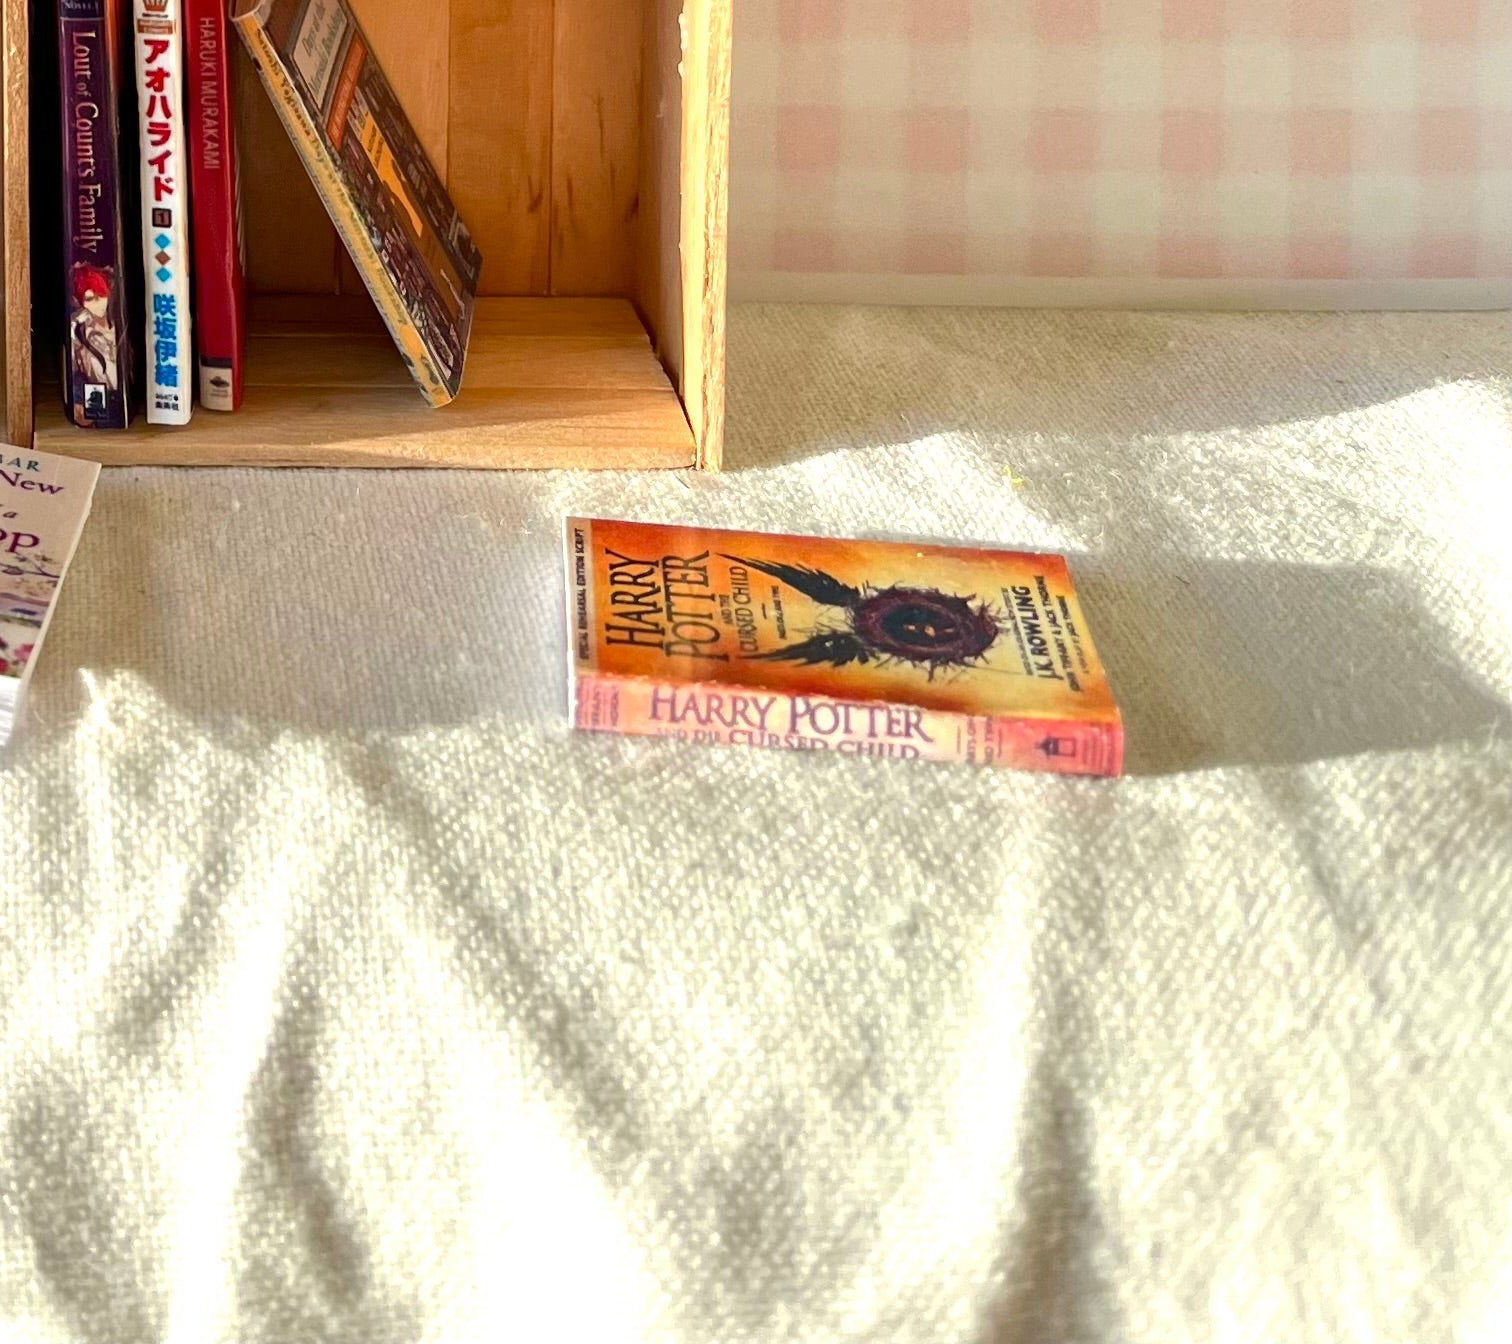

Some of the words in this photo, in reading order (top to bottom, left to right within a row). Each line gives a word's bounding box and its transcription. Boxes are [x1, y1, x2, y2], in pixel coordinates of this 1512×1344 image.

[72, 31, 96, 80] Lout
[199, 16, 217, 76] HARUKI
[143, 38, 174, 201] アオハライド
[200, 81, 221, 170] MURAKAMI
[73, 183, 104, 253] Family
[2, 510, 19, 520] a
[574, 528, 585, 554] SCRIPT
[604, 547, 666, 649] HARRY
[661, 550, 730, 662] POTTER
[729, 566, 752, 606] CHILD
[735, 606, 760, 653] CURSED
[1011, 585, 1051, 656] ROWLING
[648, 684, 777, 731] HARRY
[788, 695, 936, 743] POTTER
[839, 741, 921, 760] CHILD
